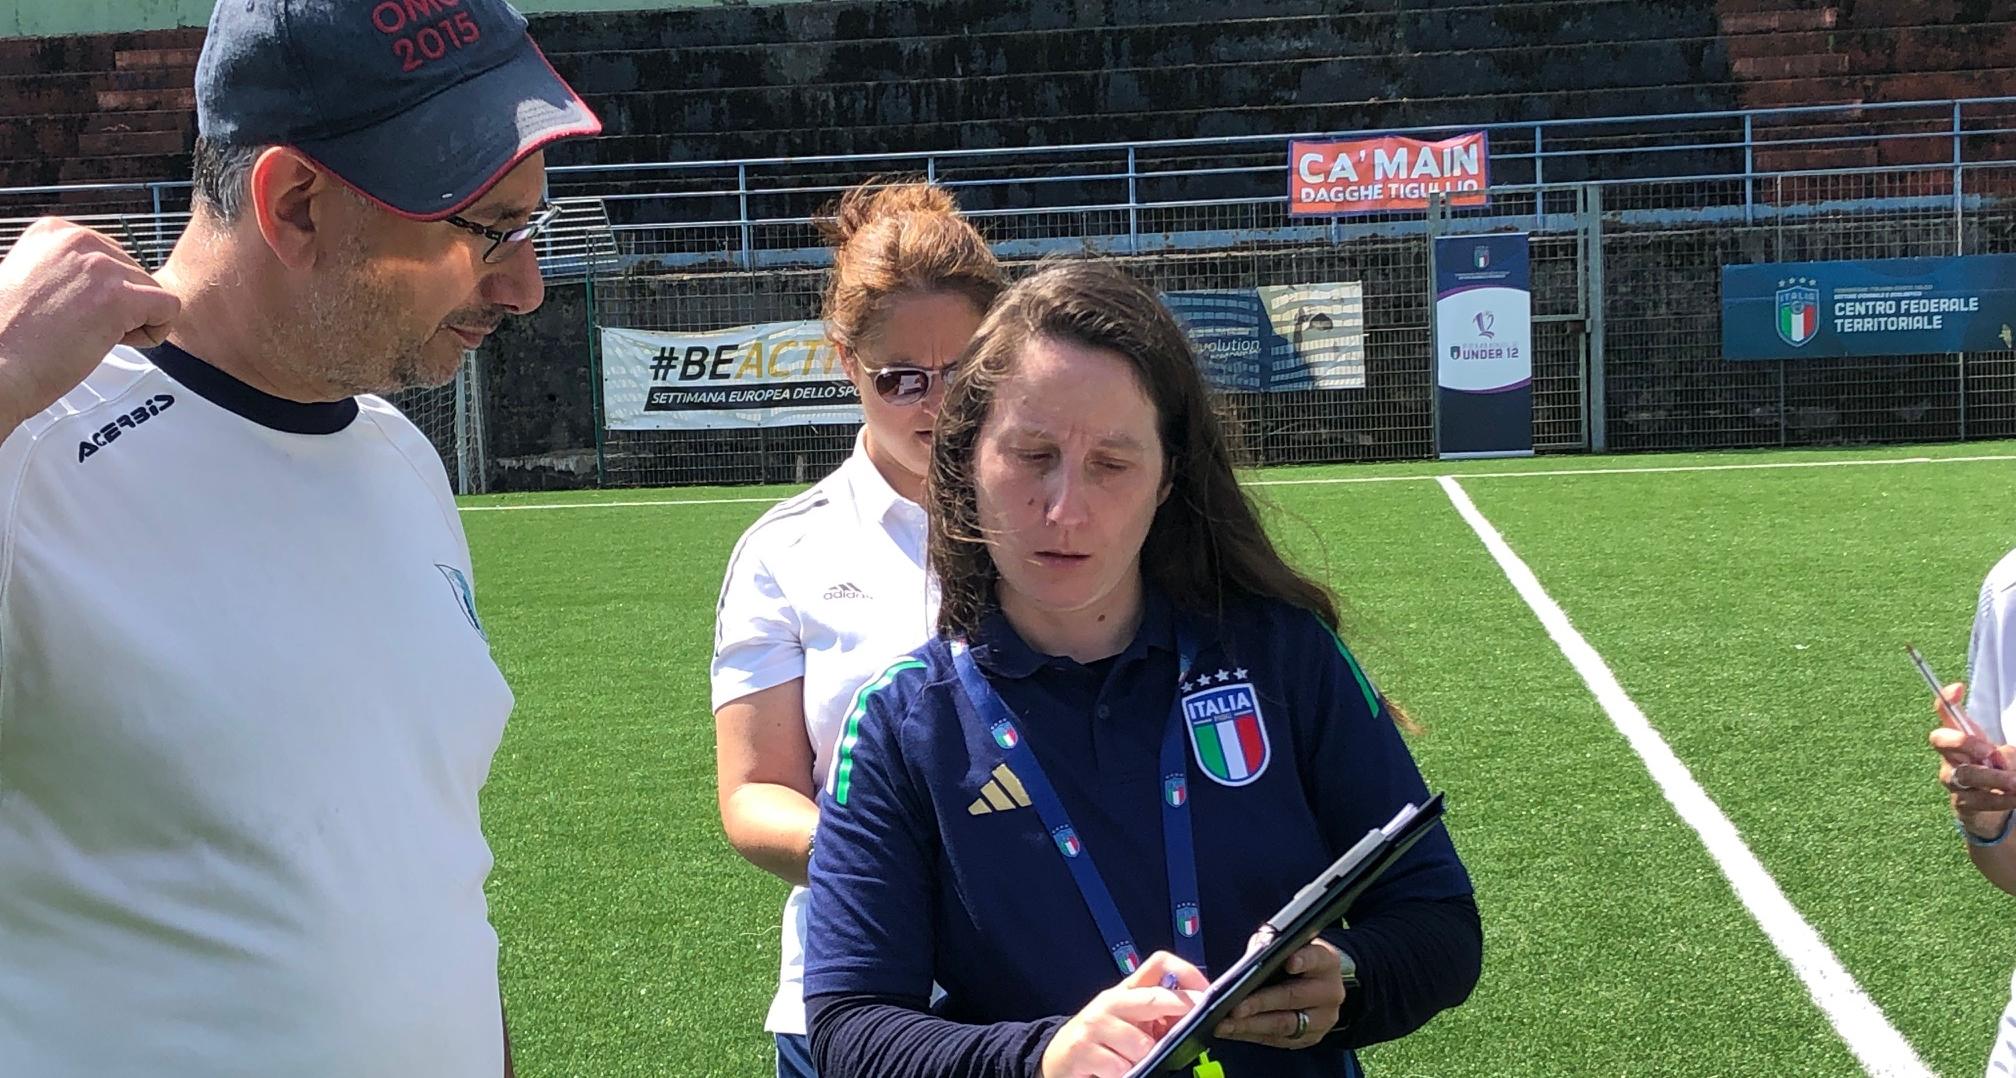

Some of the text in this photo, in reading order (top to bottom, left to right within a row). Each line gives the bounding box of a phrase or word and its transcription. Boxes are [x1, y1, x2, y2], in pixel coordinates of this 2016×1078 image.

[372, 0, 461, 34] OM
[393, 11, 480, 72] 2015
[1301, 182, 1384, 203] DAGGHE
[1834, 297, 1979, 316] CENTRO FEDERALE
[1834, 315, 1943, 333] TERRITORIALE
[1463, 347, 1519, 360] UNDER 12
[651, 391, 726, 404] SETTIMANA
[728, 389, 790, 403] EUROPEA
[793, 386, 836, 399] DELLO
[1188, 692, 1252, 720] ITALIA
